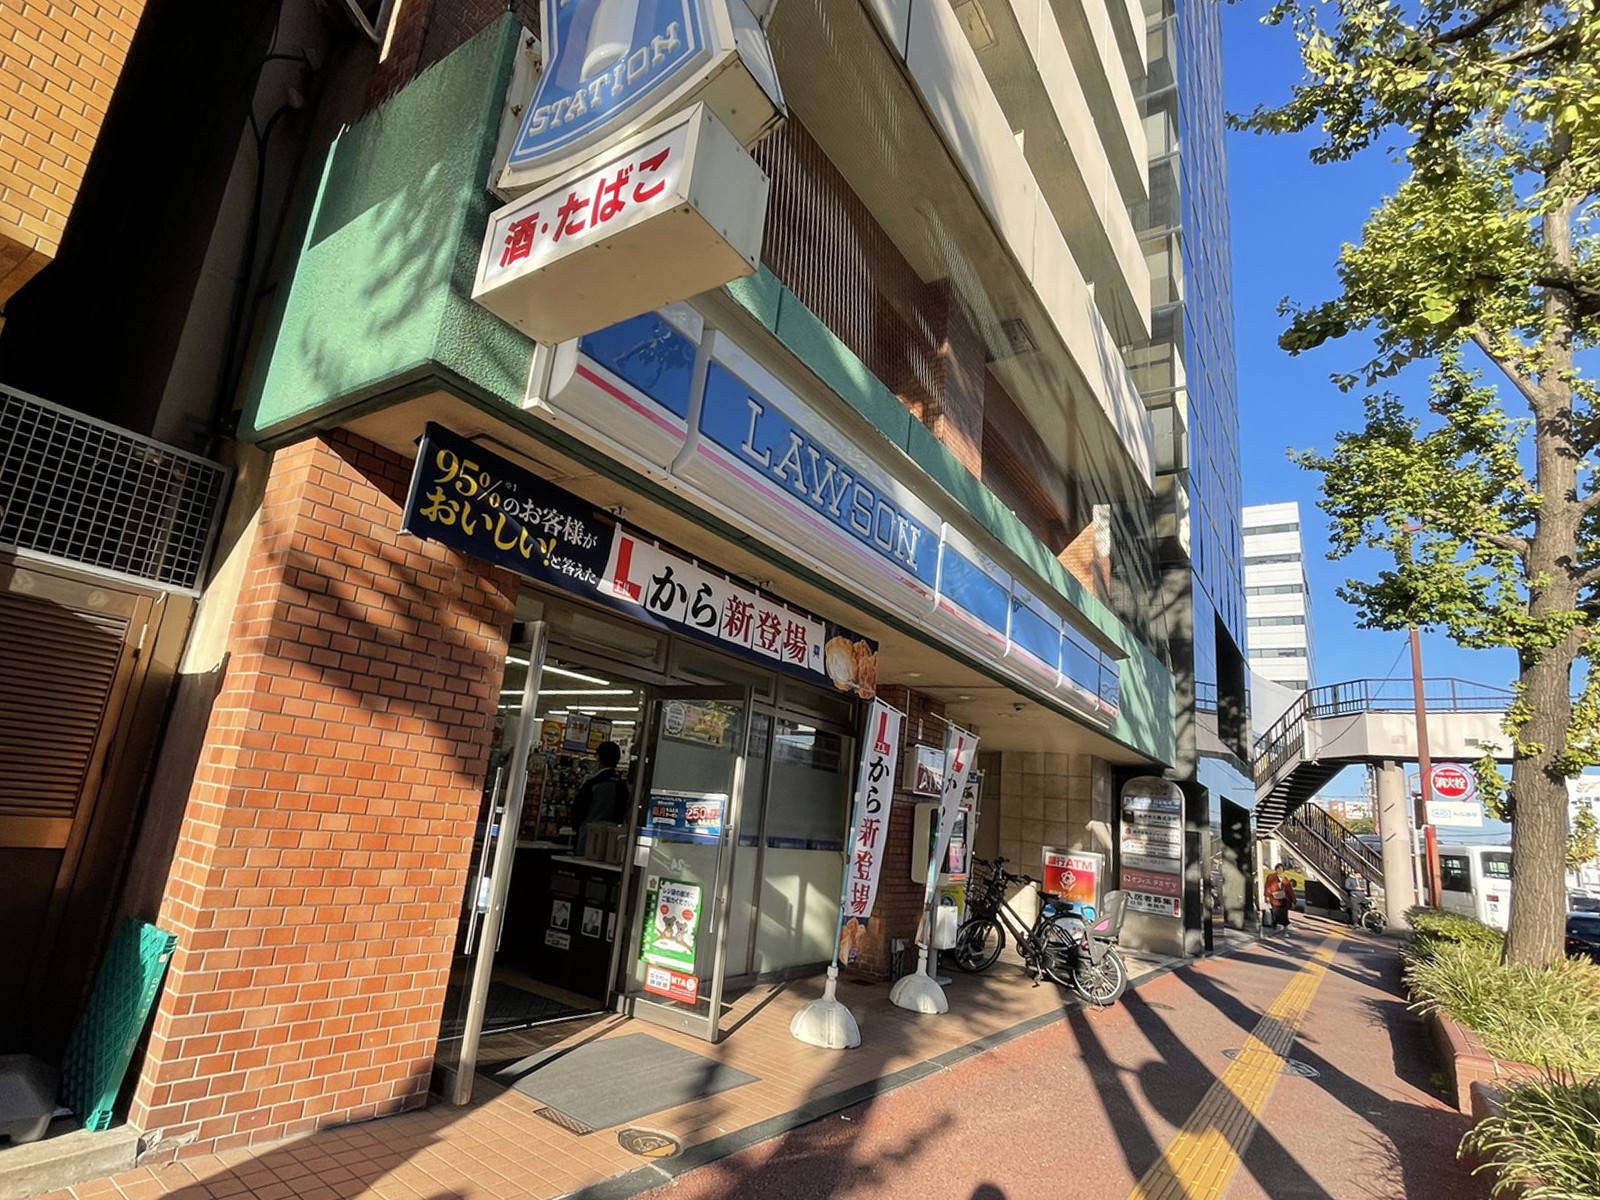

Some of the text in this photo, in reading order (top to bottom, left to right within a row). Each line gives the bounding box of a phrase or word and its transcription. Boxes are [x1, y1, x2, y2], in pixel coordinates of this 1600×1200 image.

[528, 21, 680, 137] STATION
[499, 147, 671, 269] 酒・たばこ
[741, 397, 921, 572] LAWSON
[1434, 776, 1468, 790] 消火栓
